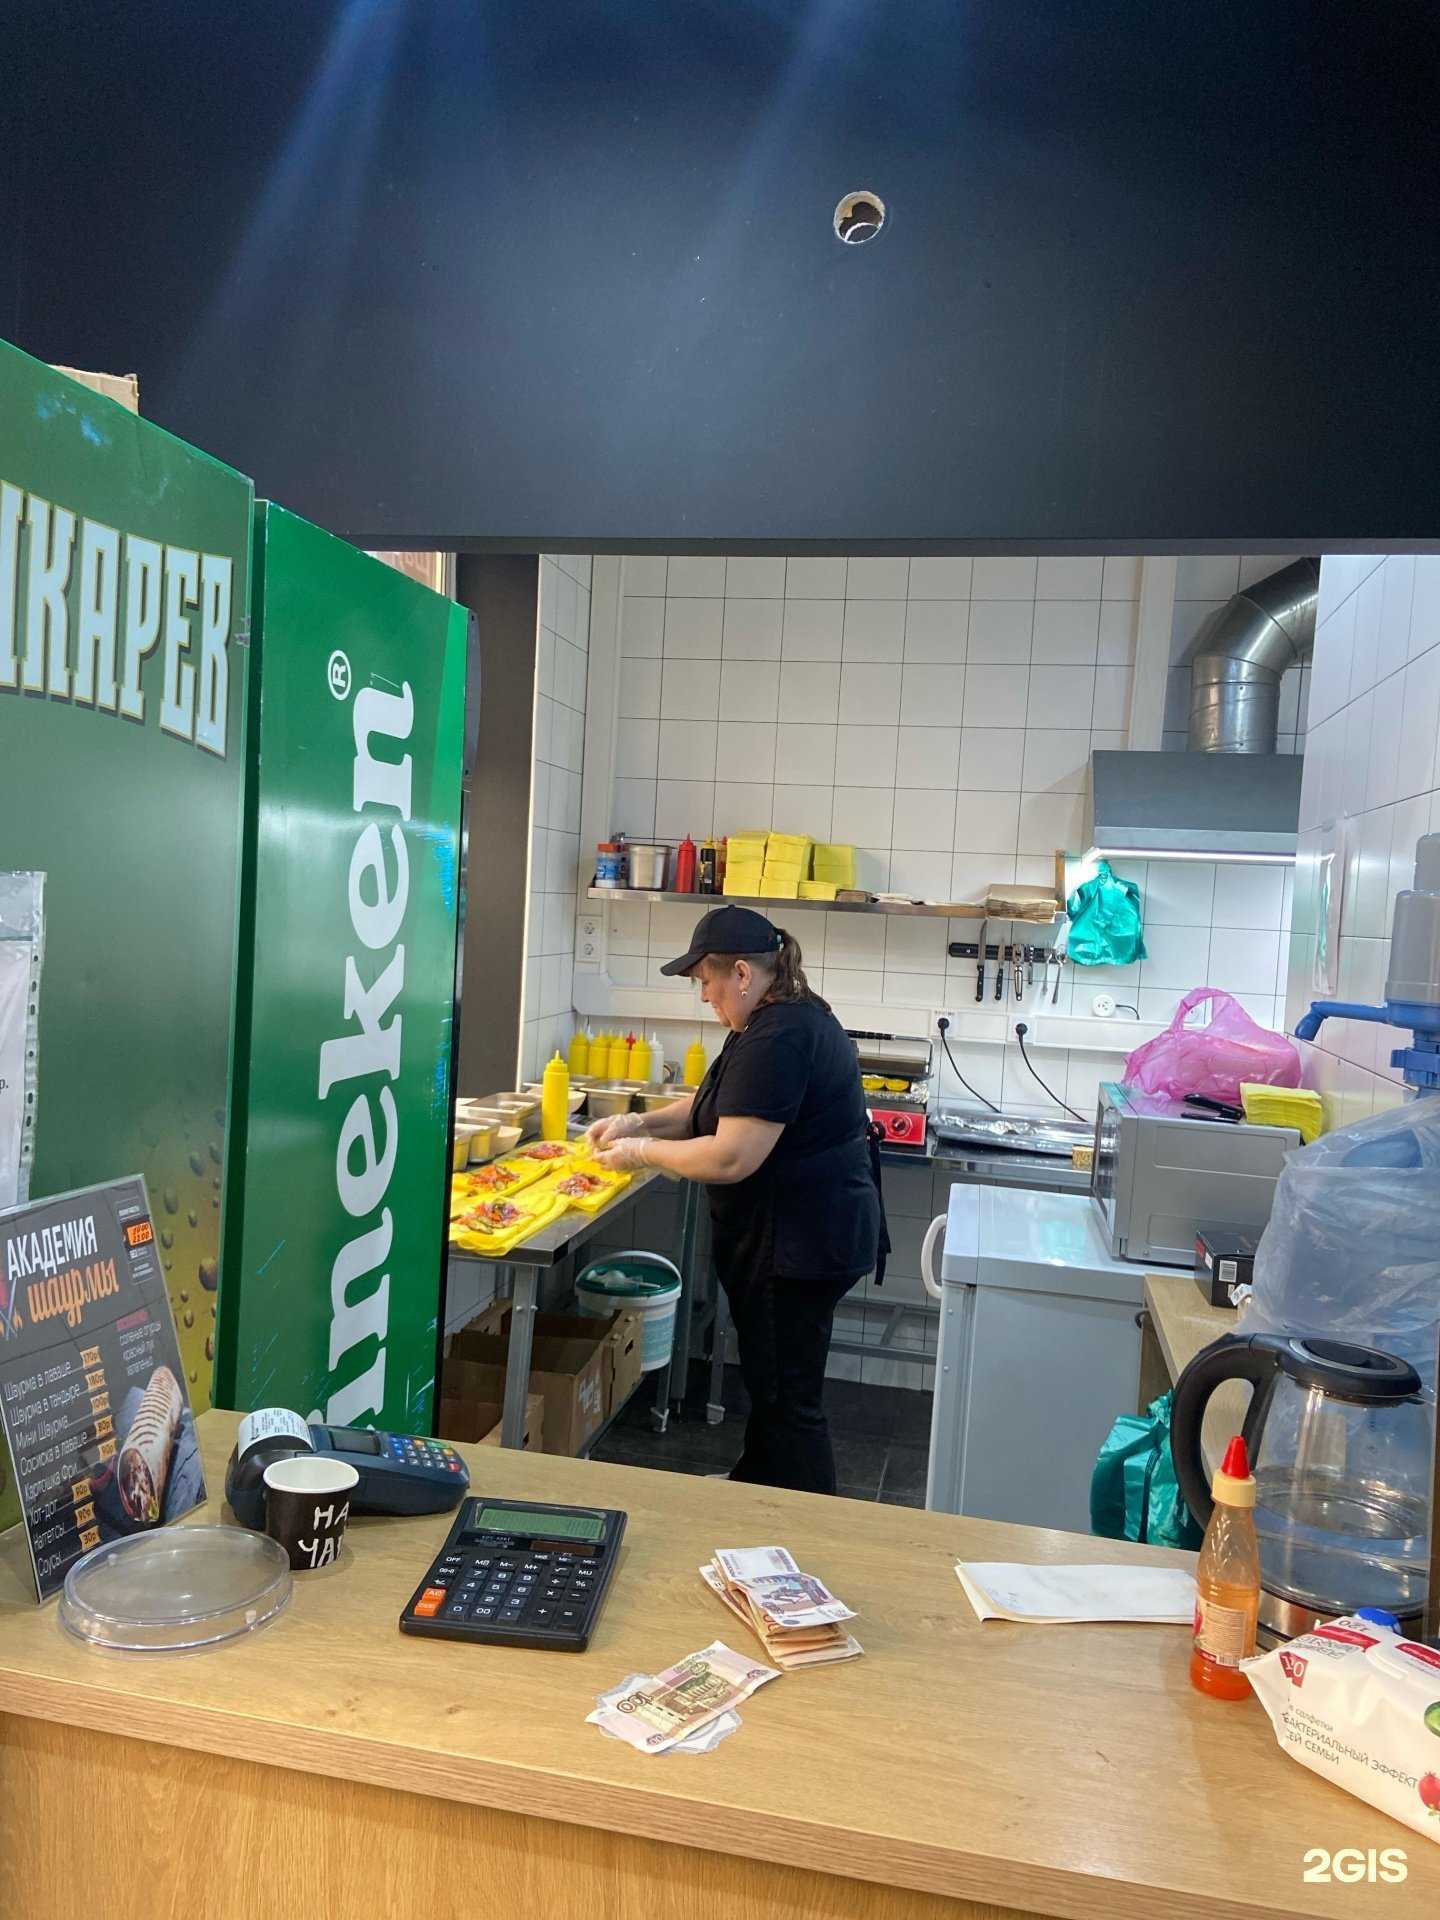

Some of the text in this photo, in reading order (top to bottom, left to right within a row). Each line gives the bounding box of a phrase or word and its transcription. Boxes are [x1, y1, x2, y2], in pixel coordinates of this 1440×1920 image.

[306, 681, 414, 1430] ineken
[7, 1216, 98, 1280] АКАДЕМИЯ
[27, 1257, 119, 1328] шаурмы
[4, 1376, 37, 1400] Шаурма
[38, 1373, 44, 1387] в
[10, 1401, 42, 1426] Шаурма
[43, 1398, 49, 1411] в
[16, 1430, 37, 1449] Мини
[38, 1415, 68, 1440] Шаурма
[55, 1445, 60, 1459] в
[313, 1501, 350, 1531] НА
[37, 1552, 62, 1577] Соусы
[1304, 1740, 1340, 1765] СЕМЬИ
[1371, 1759, 1418, 1789] ЭФФЕКТ
